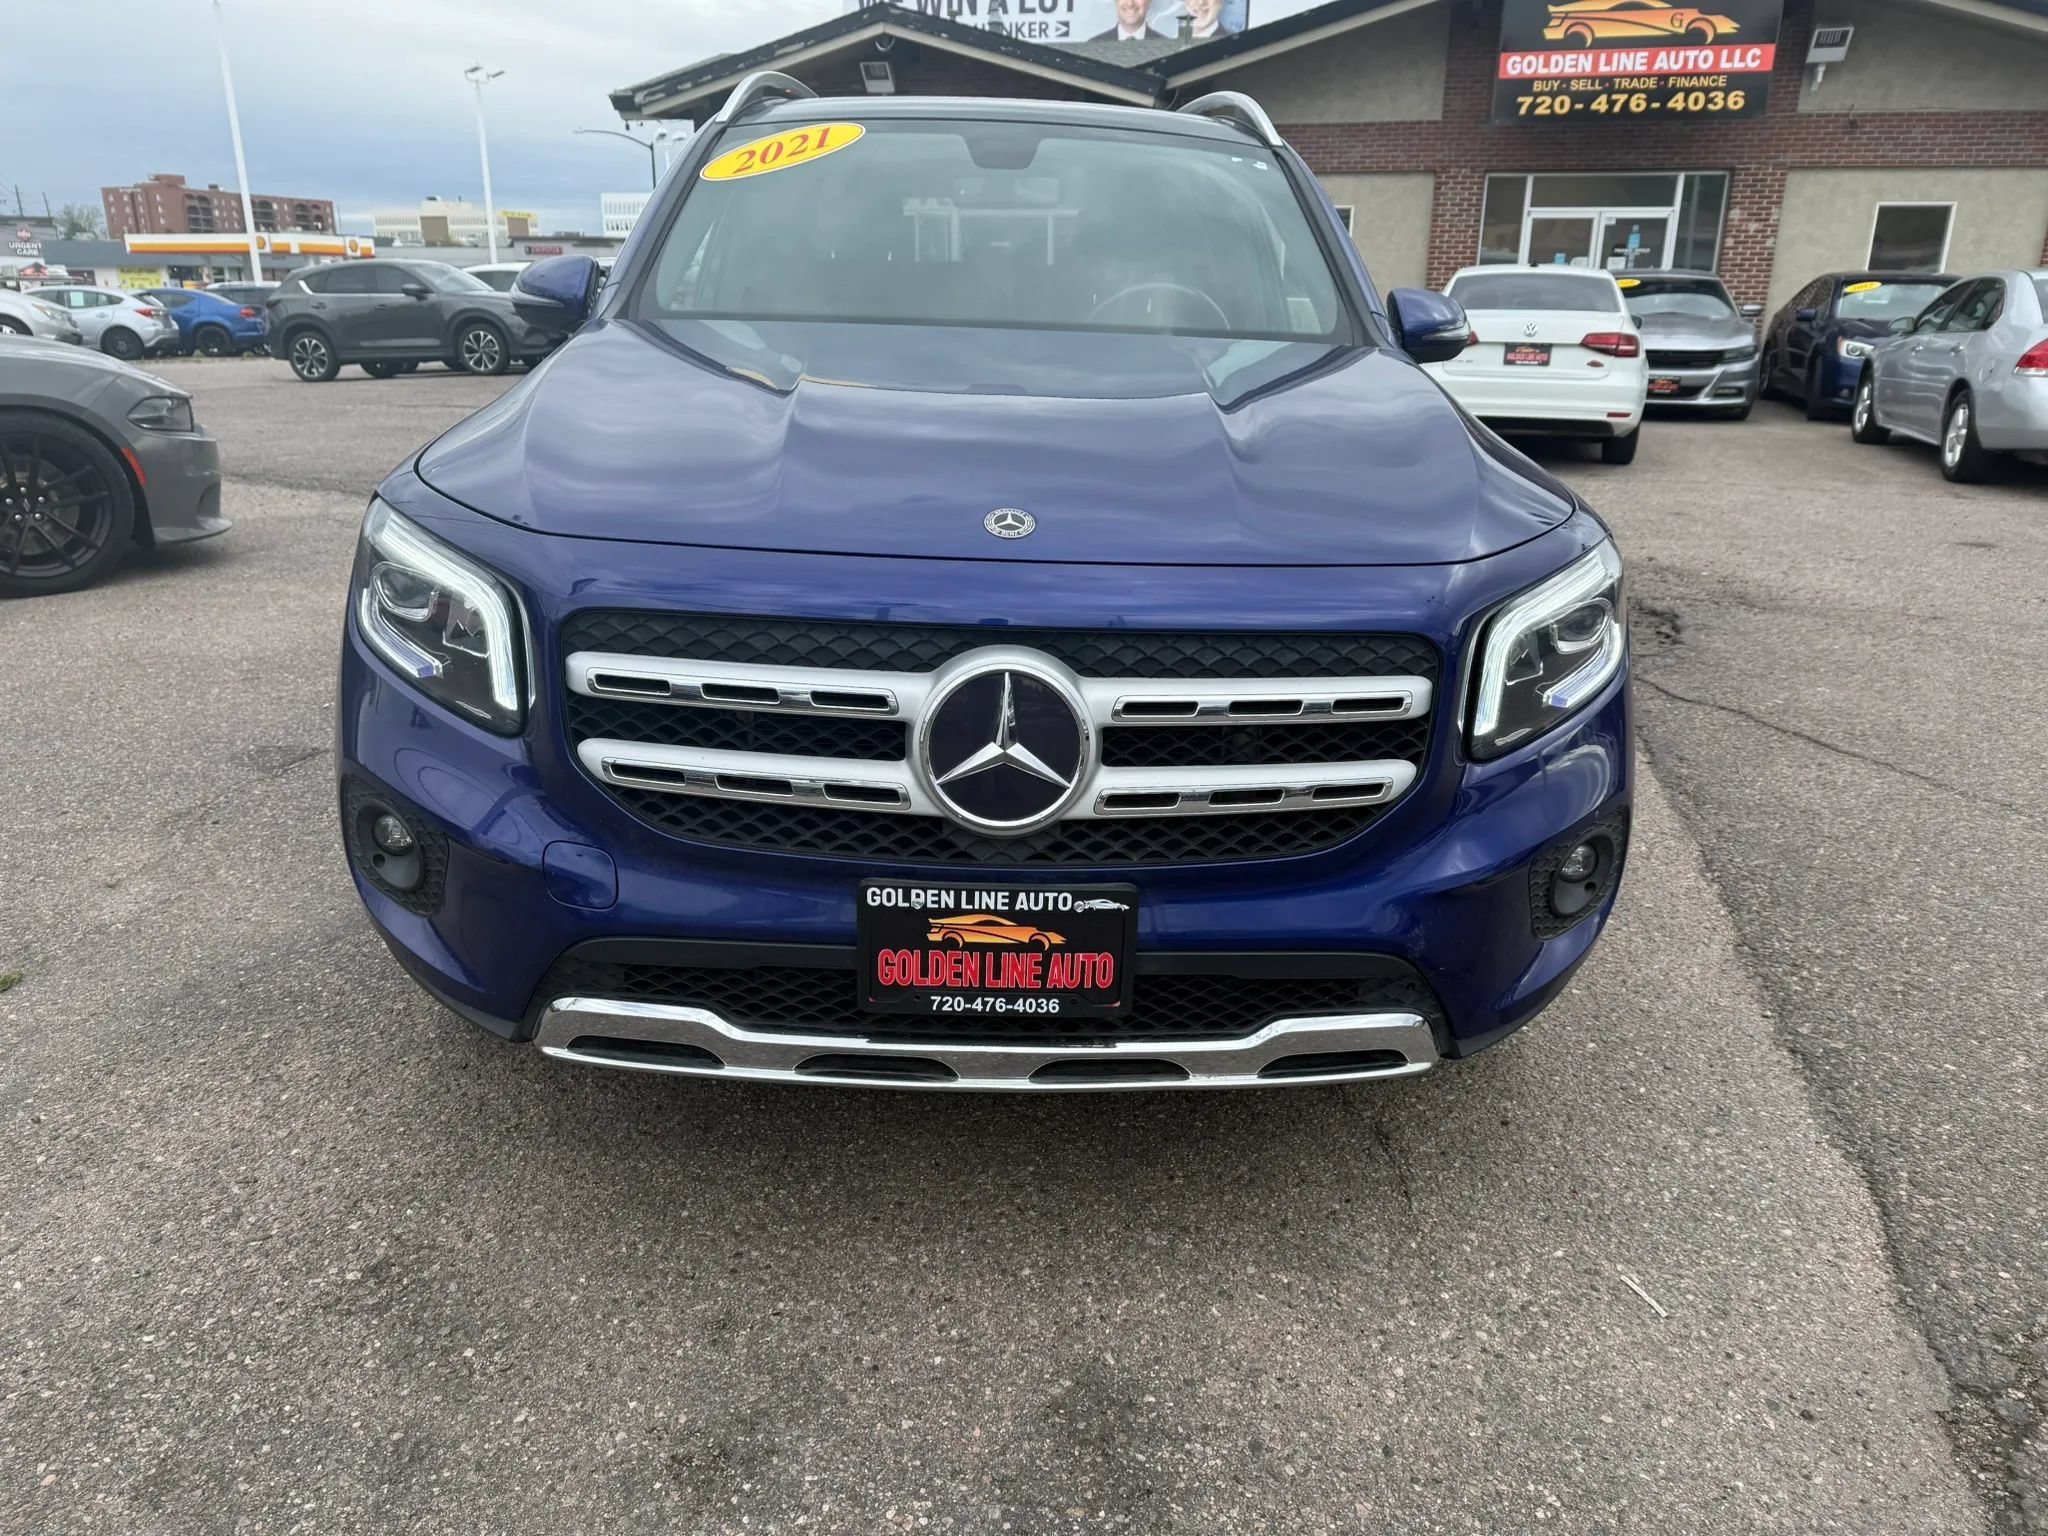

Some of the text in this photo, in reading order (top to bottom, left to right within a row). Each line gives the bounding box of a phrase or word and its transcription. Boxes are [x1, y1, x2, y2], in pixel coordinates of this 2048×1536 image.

[1507, 48, 1761, 75] GOLDEN LINE AUTO LLC
[1532, 75, 1728, 92] BUY SELL TRADE FINANCE
[732, 126, 831, 174] 2021
[866, 887, 1073, 912] GOLDEN LINE AUTO
[877, 948, 1114, 989] GOLDEN LINE AUTO
[930, 995, 1060, 1014] 720-476-4036
